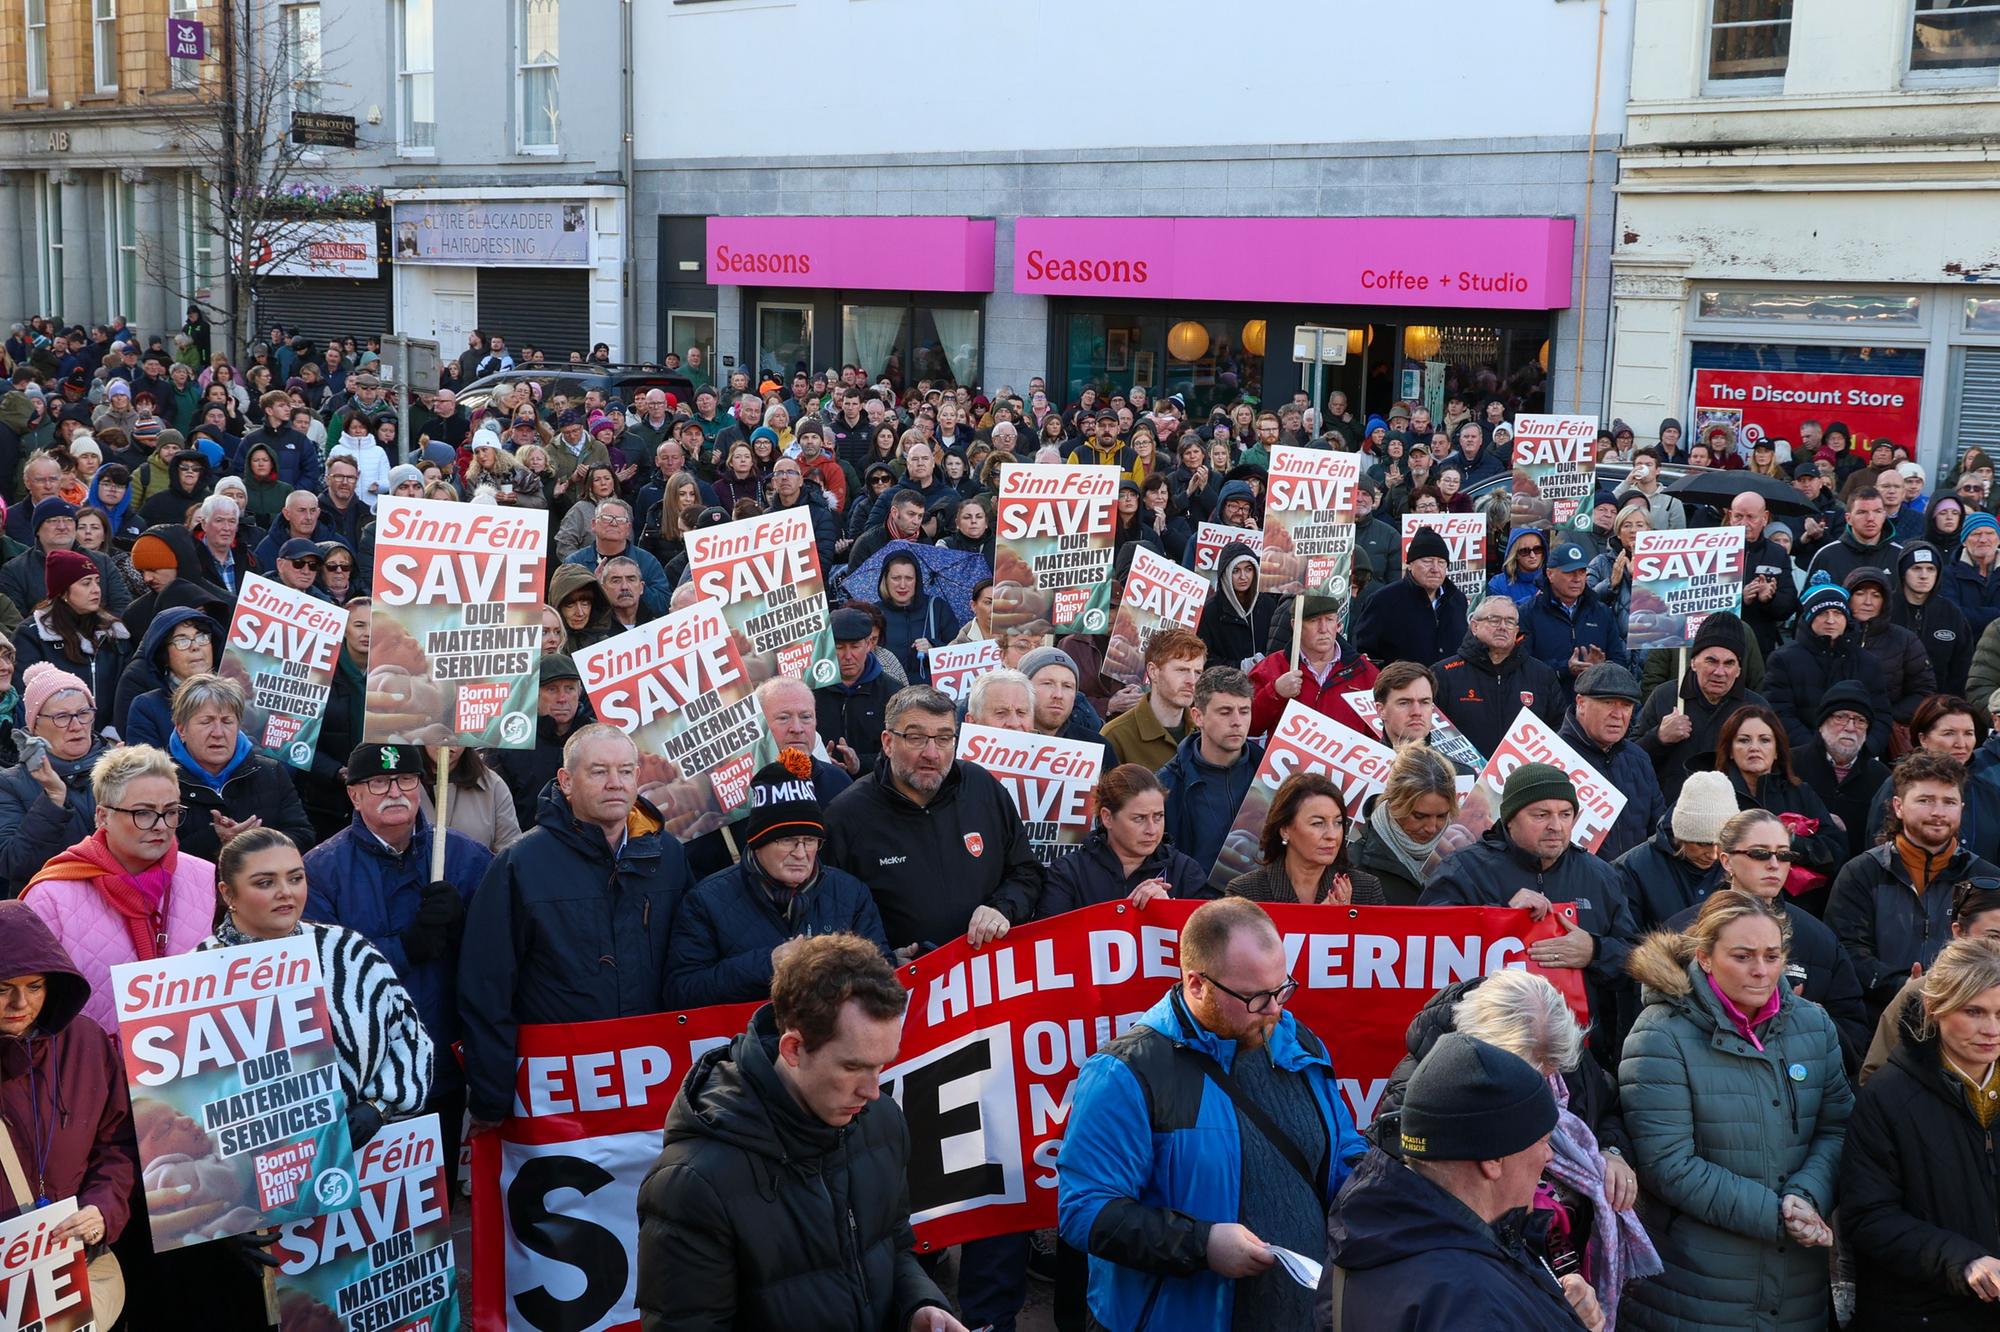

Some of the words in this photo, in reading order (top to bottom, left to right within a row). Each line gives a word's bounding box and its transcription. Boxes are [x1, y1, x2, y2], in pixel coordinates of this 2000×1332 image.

[177, 42, 198, 55] AIB
[296, 117, 314, 127] THE
[316, 119, 353, 131] GROTTO
[48, 132, 68, 150] AIB
[468, 213, 553, 230] BLACKADDER
[441, 237, 536, 254] HAIRDRESSING
[717, 245, 810, 273] Seasons
[1026, 250, 1148, 283] Seasons
[1361, 269, 1429, 290] Coffee
[1458, 271, 1528, 292] Studio
[1710, 384, 1747, 401] The
[1751, 385, 1842, 406] Discount
[1847, 388, 1905, 407] Store
[1518, 419, 1555, 435] Sinn
[1556, 420, 1594, 437] Féin
[1516, 439, 1593, 465] SAVE
[1272, 452, 1313, 474] Sinn
[1318, 456, 1357, 479] Féin
[1556, 462, 1577, 473] OUR
[1003, 471, 1061, 496] Sinn
[1064, 472, 1116, 497] Féin
[1539, 472, 1593, 487] MATERNITY
[1269, 478, 1355, 512] SAVE
[1542, 485, 1588, 499] SERVICES
[1313, 510, 1335, 523] OUR
[1554, 501, 1571, 509] Born
[382, 508, 463, 544] Sinn
[465, 515, 540, 551] Féin
[1000, 499, 1113, 541] SAVE
[1293, 524, 1352, 539] MATERNITY
[1445, 518, 1482, 534] Féin
[693, 535, 749, 563] Sinn
[753, 518, 808, 549] Féin
[1060, 533, 1089, 550] OUR
[1200, 528, 1232, 543] Sinn
[1296, 540, 1346, 555] SERVICES
[1639, 536, 1688, 551] Sinn
[1691, 532, 1739, 549] Féin
[1034, 549, 1111, 571] MATERNITY
[1308, 559, 1326, 568] Born
[1327, 559, 1335, 567] in
[1636, 549, 1739, 582] SAVE
[379, 553, 539, 607] SAVE
[699, 541, 817, 608] SAVE
[1038, 567, 1105, 589] SERVICES
[1135, 555, 1170, 583] Sinn
[1169, 572, 1204, 599] Féin
[1308, 568, 1330, 578] Daisy
[1308, 576, 1321, 586] Hill
[1450, 570, 1484, 583] ERNITY
[1691, 574, 1717, 587] OUR
[766, 584, 797, 608] OUR
[1055, 591, 1077, 604] Born
[1079, 591, 1090, 602] in
[1126, 578, 1201, 628] SAVE
[1667, 583, 1740, 603] MATERNITY
[243, 583, 293, 619] Sinn
[293, 602, 342, 636] Féin
[465, 602, 505, 625] OUR
[745, 594, 825, 637] MATERNITY
[1055, 602, 1082, 616] Daisy
[1055, 612, 1073, 624] Hill
[1672, 597, 1733, 615] SERVICES
[232, 613, 340, 671] SAVE
[428, 626, 539, 653] MATERNITY
[755, 614, 824, 653] SERVICES
[587, 645, 652, 686] Sinn
[656, 614, 719, 658] Féin
[777, 648, 802, 664] Born
[802, 642, 813, 654] in
[934, 650, 976, 670] Sinn
[283, 661, 310, 679] OUR
[435, 651, 529, 679] SERVICES
[780, 656, 809, 674] Daisy
[255, 673, 329, 702] MATERNITY
[458, 685, 492, 701] Born
[494, 684, 508, 699] in
[600, 637, 741, 735] SAVE
[256, 691, 318, 716] SERVICES
[459, 700, 499, 718] Daisy
[684, 689, 723, 724] OUR
[266, 727, 293, 740] Daisy
[268, 715, 290, 729] Born
[291, 719, 301, 731] in
[460, 715, 485, 731] Hill
[664, 693, 757, 762] MATERNITY
[265, 736, 281, 748] Hill
[1281, 714, 1344, 758] Sinn
[680, 720, 762, 779] SERVICES
[962, 735, 1026, 770] Sinn
[1030, 745, 1095, 780] Féin
[710, 764, 739, 786] Born
[739, 755, 754, 773] in
[717, 772, 751, 797] Daisy
[723, 788, 746, 809] Hill
[1024, 821, 1058, 841] OUR
[124, 972, 216, 1013] Sinn
[223, 950, 311, 996] Féin
[927, 938, 1074, 1027] HILL
[131, 995, 325, 1087] SAVE
[243, 1050, 291, 1086] OUR
[204, 1066, 337, 1130] MATERNITY
[221, 1099, 334, 1157] SERVICES
[255, 1148, 296, 1174] Born
[298, 1141, 315, 1159] in
[359, 1131, 435, 1179] Féin
[260, 1162, 308, 1192] Daisy
[265, 1183, 296, 1208] Hill
[279, 1167, 443, 1276] SAVE
[372, 1229, 413, 1269] OUR
[338, 1242, 449, 1314] MATERNITY
[351, 1275, 446, 1332] SERVICES
